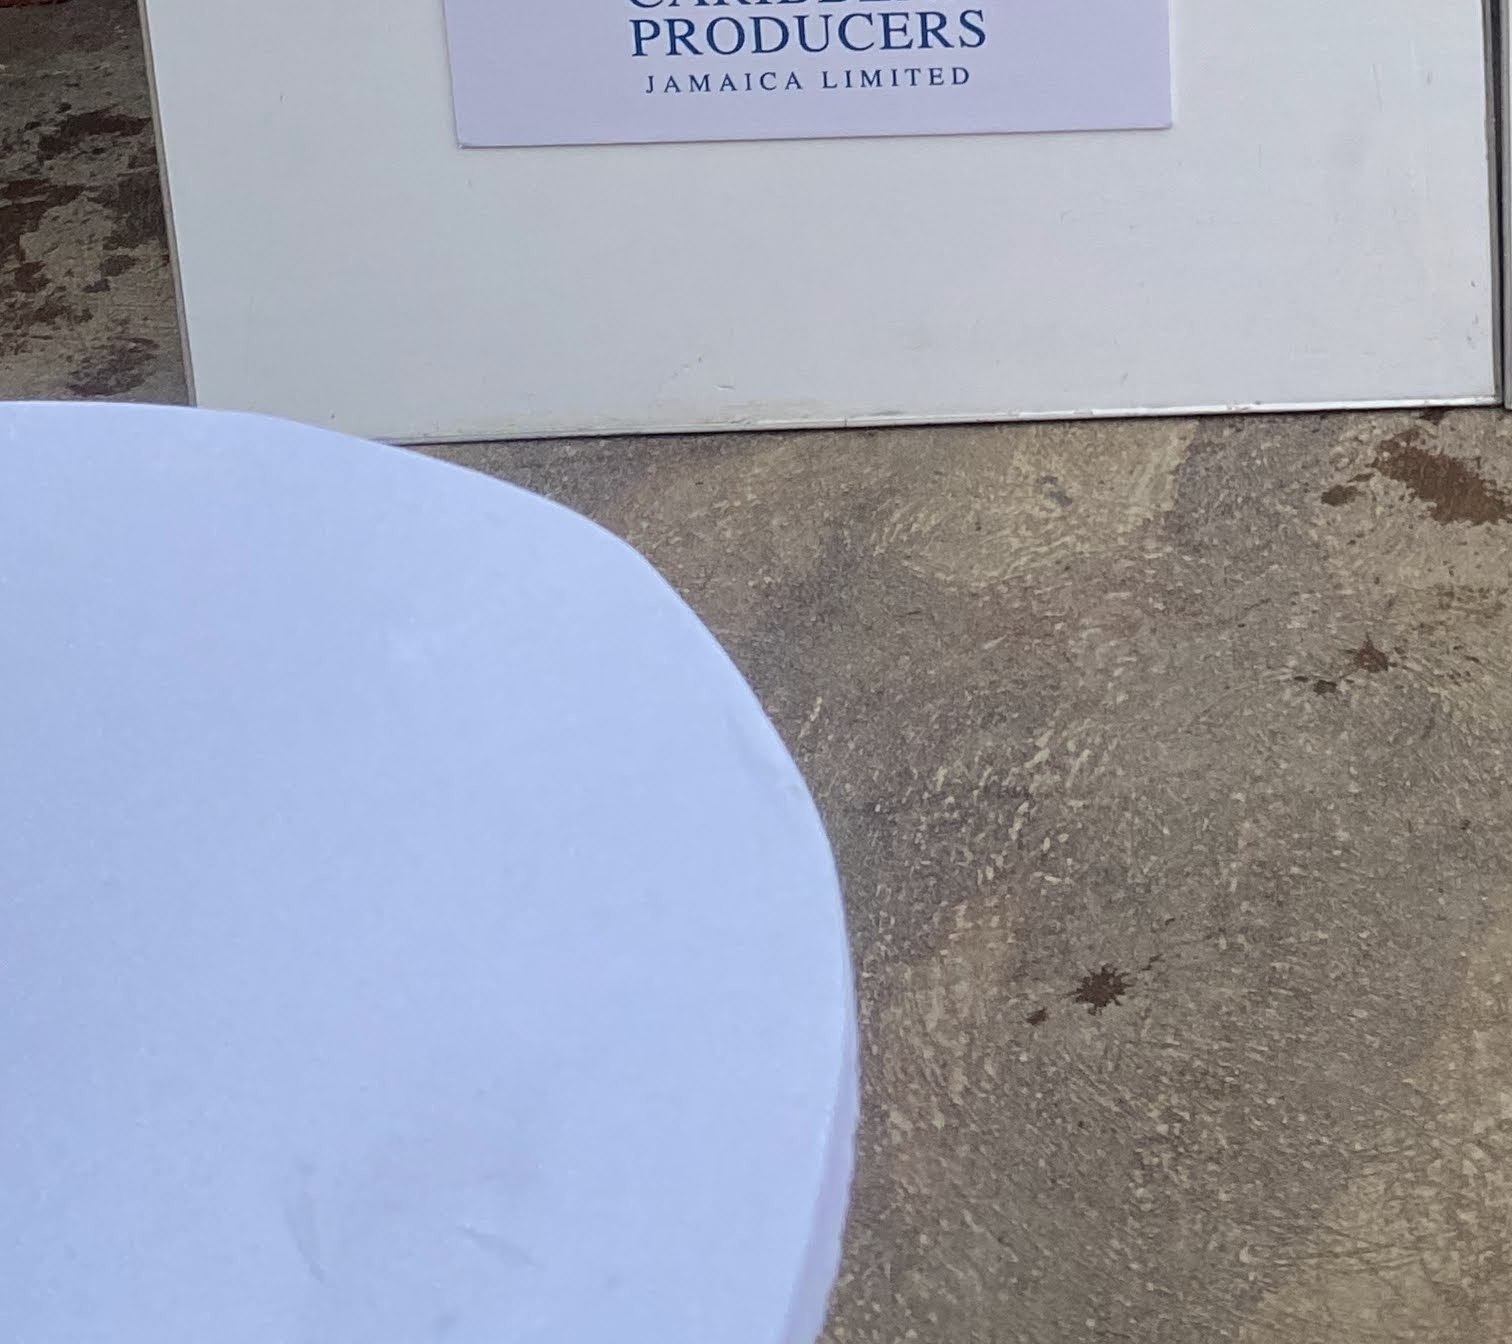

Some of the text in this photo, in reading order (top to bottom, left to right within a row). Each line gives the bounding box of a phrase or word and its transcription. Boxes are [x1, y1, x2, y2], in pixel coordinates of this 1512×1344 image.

[630, 10, 985, 55] PRODUCERS
[646, 68, 969, 93] JAMAICA LIMITED
